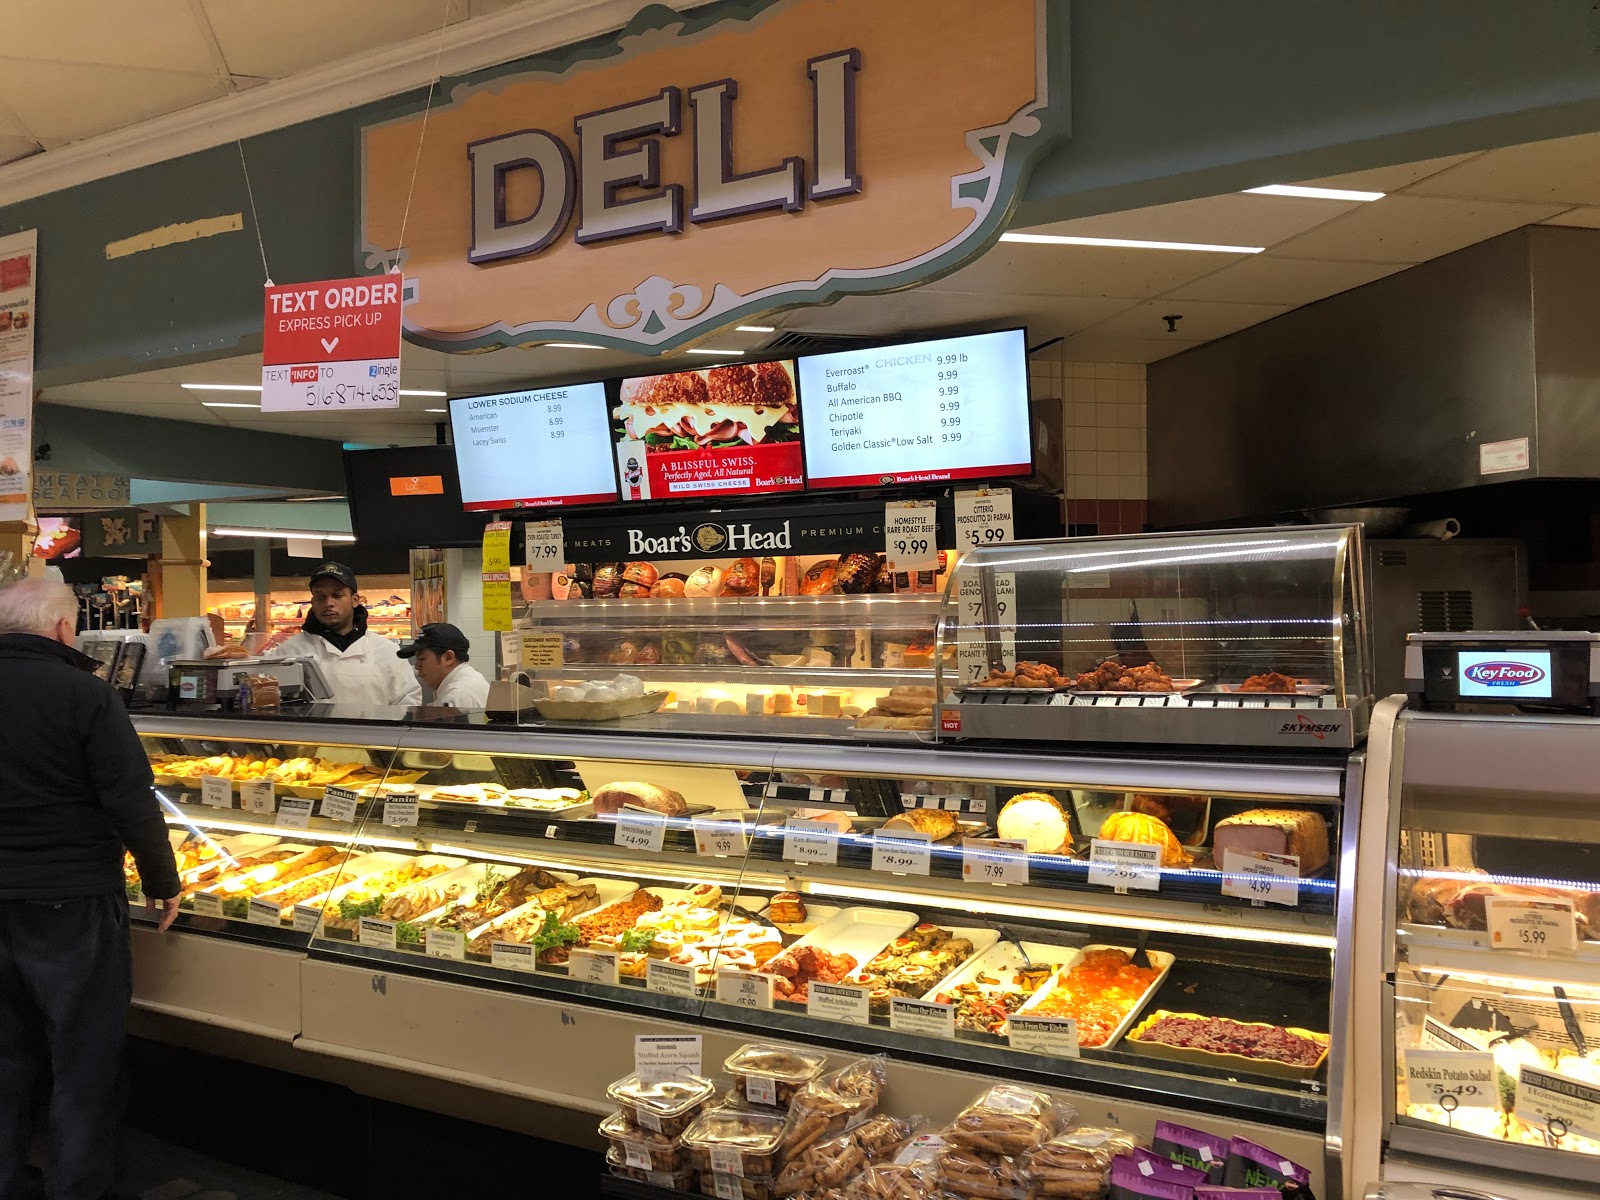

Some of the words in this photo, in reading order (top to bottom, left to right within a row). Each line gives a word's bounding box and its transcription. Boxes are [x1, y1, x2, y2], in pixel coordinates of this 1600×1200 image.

[468, 47, 862, 265] DELI
[270, 290, 319, 314] TEXT
[324, 283, 397, 309] ORDER
[279, 316, 331, 332] EXPRESS
[334, 313, 361, 328] PICK
[365, 312, 382, 326] UP
[875, 353, 932, 369] CHICKEN
[937, 355, 957, 366] 9.99
[959, 353, 968, 363] lb
[266, 370, 289, 381] TEXT
[320, 367, 334, 379] TO
[827, 382, 857, 393] Buffalo
[938, 370, 958, 381] 9.99
[468, 398, 498, 410] LOWER
[499, 395, 532, 407] SODIUM
[533, 391, 568, 402] CHEESE
[828, 398, 839, 408] All
[840, 395, 881, 407] American
[883, 392, 902, 402] BBQ
[939, 386, 959, 396] 9.99
[469, 412, 497, 421] American
[547, 405, 562, 413] 8.99
[829, 412, 864, 423] Chipotle
[940, 401, 960, 412] 9.99
[471, 424, 499, 434] Muenster
[549, 417, 563, 426] 8.99
[830, 426, 862, 438] Teriyaki
[941, 417, 961, 427] 9.99
[472, 438, 489, 447] Lacey
[490, 437, 507, 445] Swiss
[550, 431, 565, 439] 8.99
[831, 441, 861, 452] Golden
[896, 436, 914, 446] Low
[916, 435, 933, 445] Salt
[941, 432, 962, 443] 9.99
[661, 464, 667, 472] A
[671, 459, 720, 471] BLISSFUL
[664, 470, 692, 480] Perfectly
[694, 469, 712, 479] Aged,
[714, 468, 724, 477] All
[726, 466, 753, 476] Natural
[931, 472, 950, 480] Brand
[38, 474, 102, 487] MEAT
[718, 479, 747, 487] CHEESE
[784, 475, 803, 486] Head
[973, 505, 993, 513] CITTERIO
[894, 517, 926, 525] HOMESTYLE
[957, 514, 986, 523] PROSCIUTTO
[994, 513, 1011, 521] PARMA
[801, 527, 863, 537] PREMIUM
[902, 525, 920, 533] ROAST
[965, 528, 1004, 544] $5.99
[575, 539, 611, 547] MEATS
[627, 526, 691, 555] Boar's
[726, 520, 792, 550] Head
[532, 545, 557, 558] $7.99
[894, 540, 928, 554] $9.99
[1471, 667, 1498, 679] Key
[1499, 667, 1534, 678] Food
[1281, 724, 1340, 732] SKYMSEN
[326, 787, 356, 799] Panini
[386, 795, 418, 803] Panini
[984, 865, 1004, 878] $7.99
[1250, 880, 1271, 894] $4.99
[1519, 930, 1545, 944] $5.99
[1409, 1067, 1442, 1079] Redskin
[1443, 1069, 1468, 1081] Potato
[1469, 1069, 1492, 1081] Salad
[1527, 1087, 1595, 1111] Homemade
[1170, 1151, 1211, 1173] NEW
[1246, 1168, 1285, 1190] NEW
